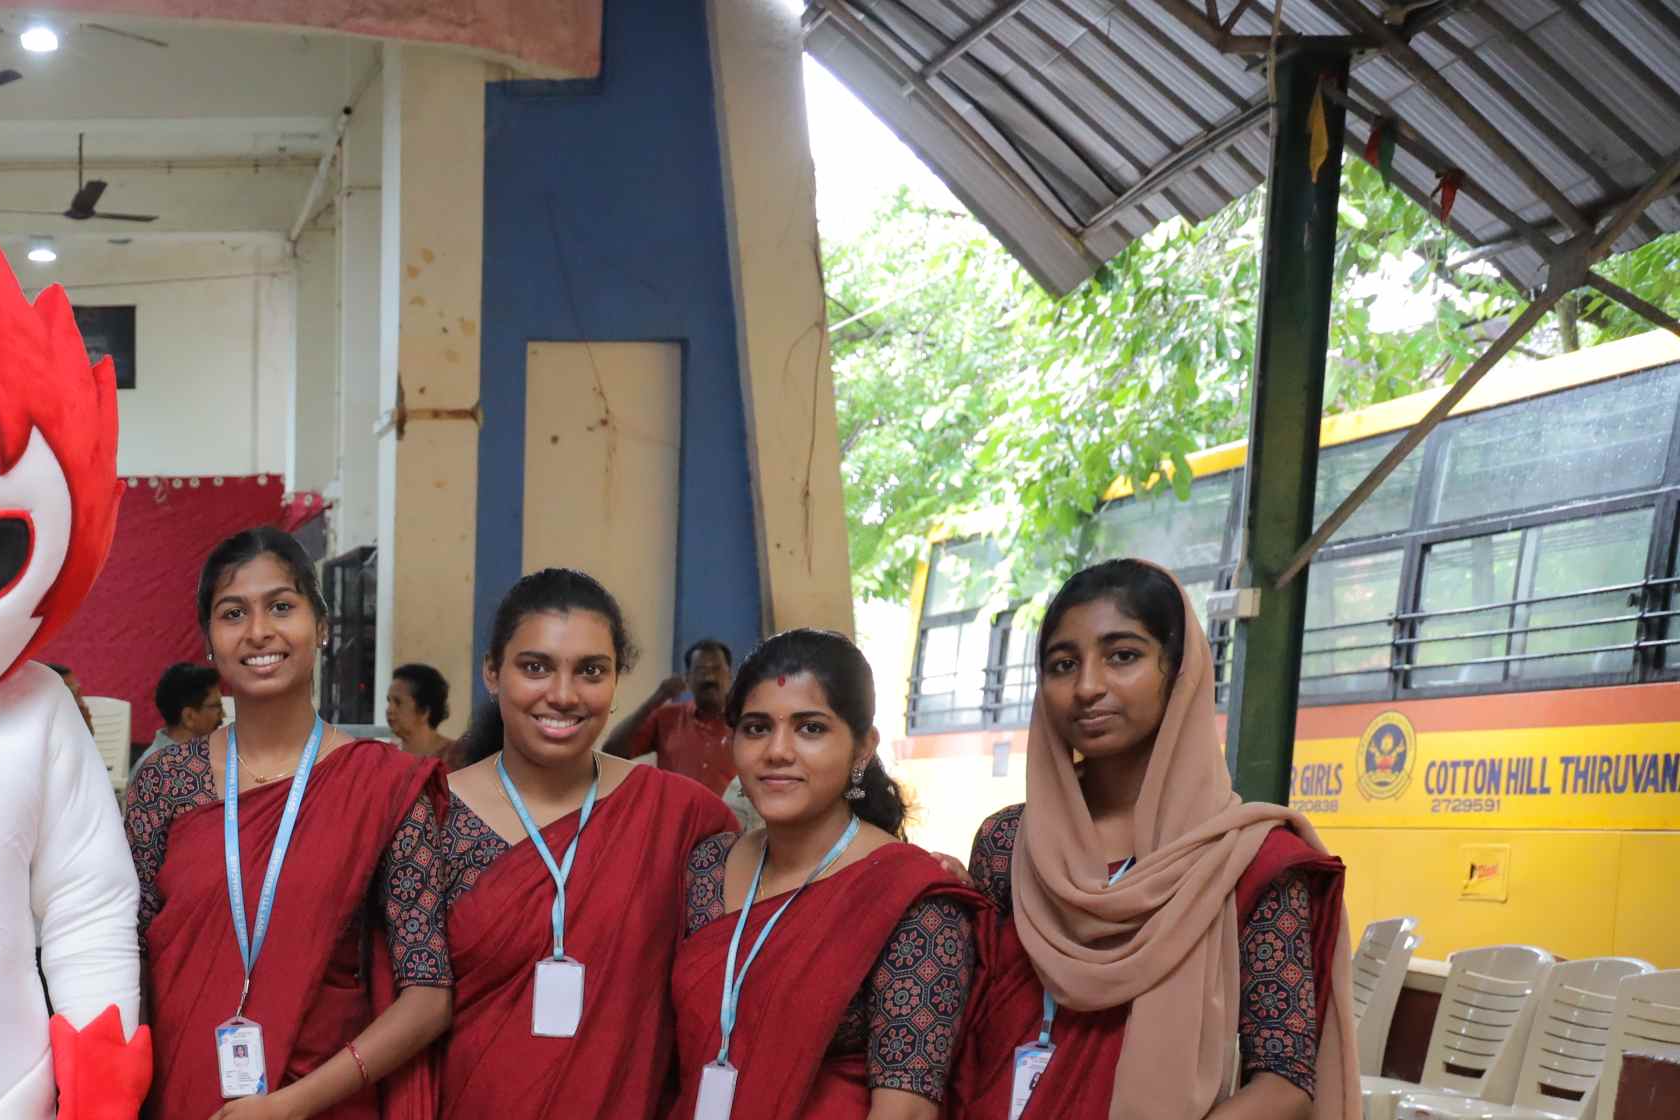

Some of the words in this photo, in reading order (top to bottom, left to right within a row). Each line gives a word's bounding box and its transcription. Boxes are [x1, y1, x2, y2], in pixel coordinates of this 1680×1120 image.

[1301, 763, 1344, 796] GIRLS
[1424, 757, 1503, 796] COTTON
[1505, 757, 1551, 795] HILL
[1560, 753, 1680, 794] THIRUVAN
[1431, 798, 1500, 813] 2729591
